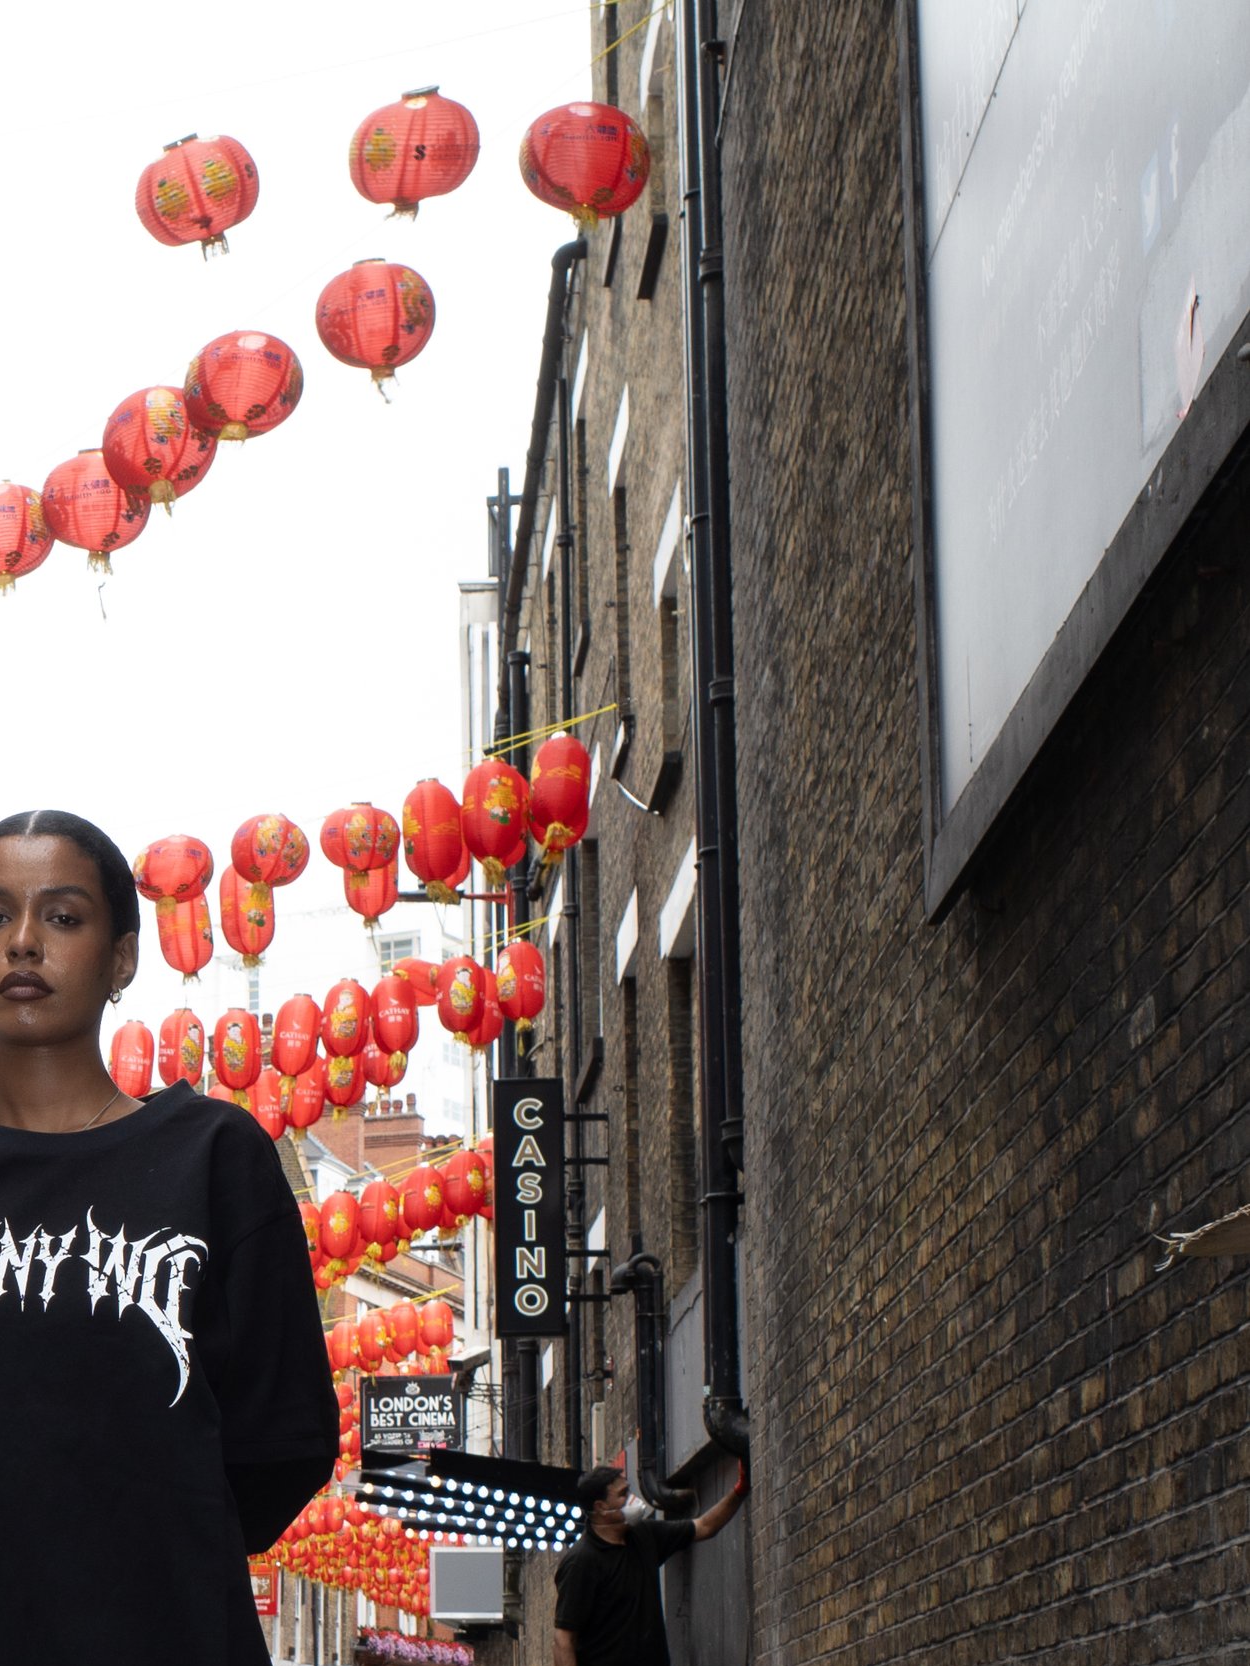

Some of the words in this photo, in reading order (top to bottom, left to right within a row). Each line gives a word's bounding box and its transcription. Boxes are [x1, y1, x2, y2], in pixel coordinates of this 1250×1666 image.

[378, 1007, 410, 1018] CATHAY
[513, 1097, 549, 1317] CASINO
[370, 1394, 453, 1413] LONDON'S
[370, 1412, 404, 1428] BEST
[408, 1411, 456, 1427] CINEMA
